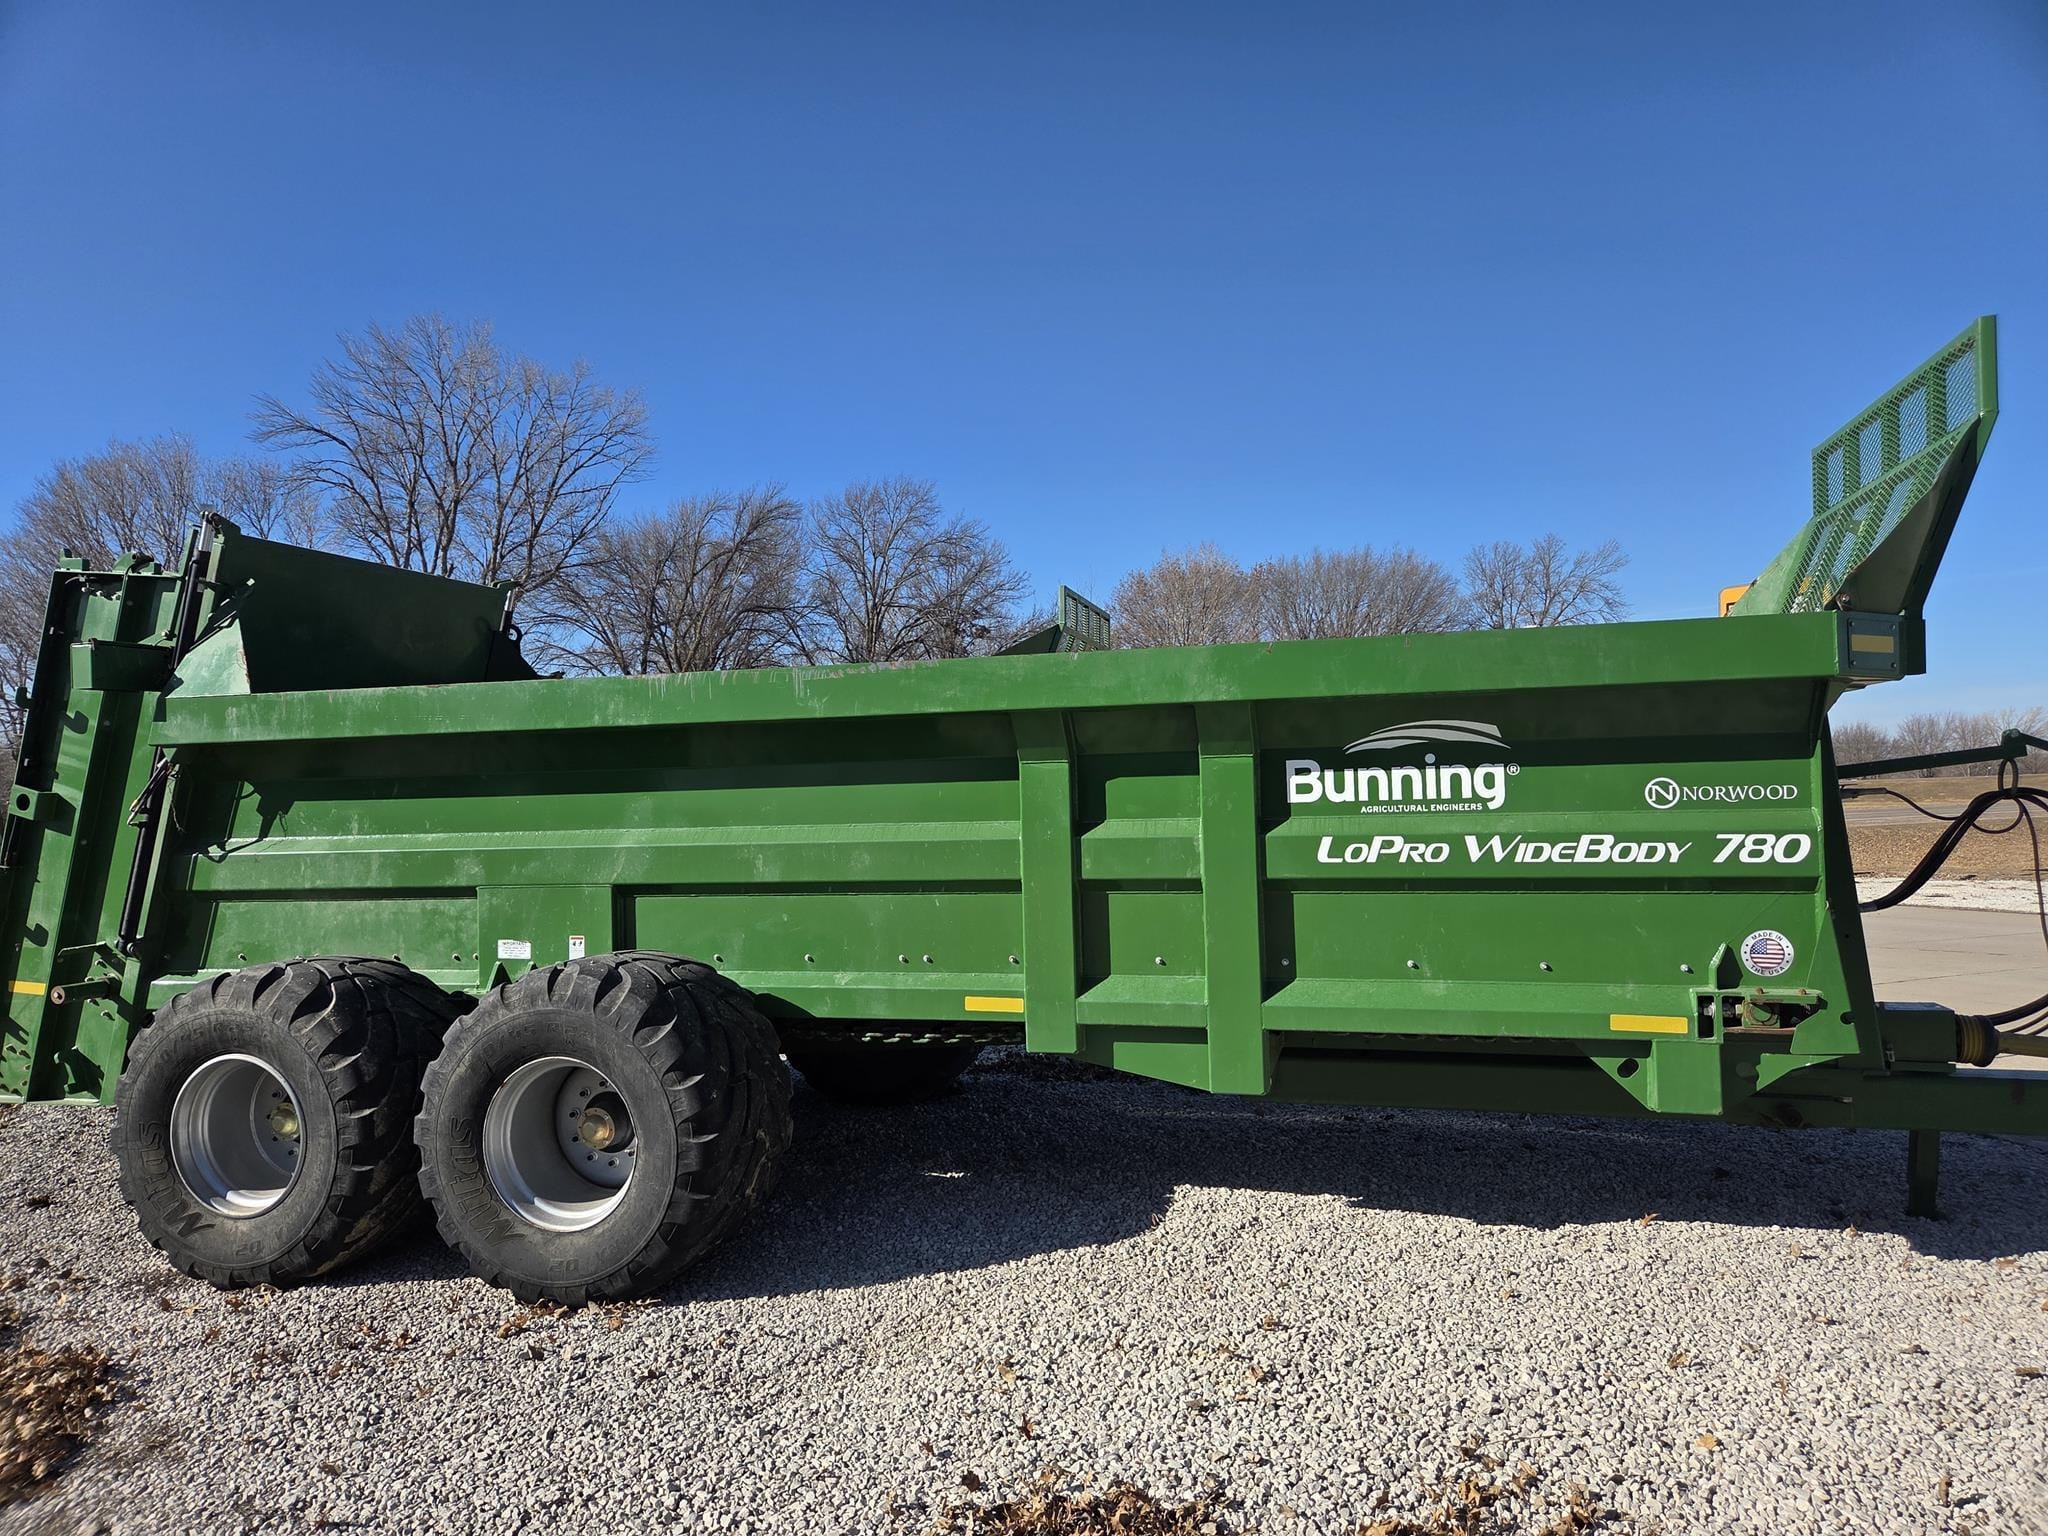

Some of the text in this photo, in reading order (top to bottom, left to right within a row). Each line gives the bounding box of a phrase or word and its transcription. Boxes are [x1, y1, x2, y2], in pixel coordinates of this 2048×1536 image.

[1682, 784, 1798, 802] NORWOOD
[1360, 803, 1483, 814] AGRICULTURAL ENGINEERS
[1713, 834, 1811, 863] 780
[1751, 932, 1772, 940] MADE
[1751, 965, 1785, 975] THE USA
